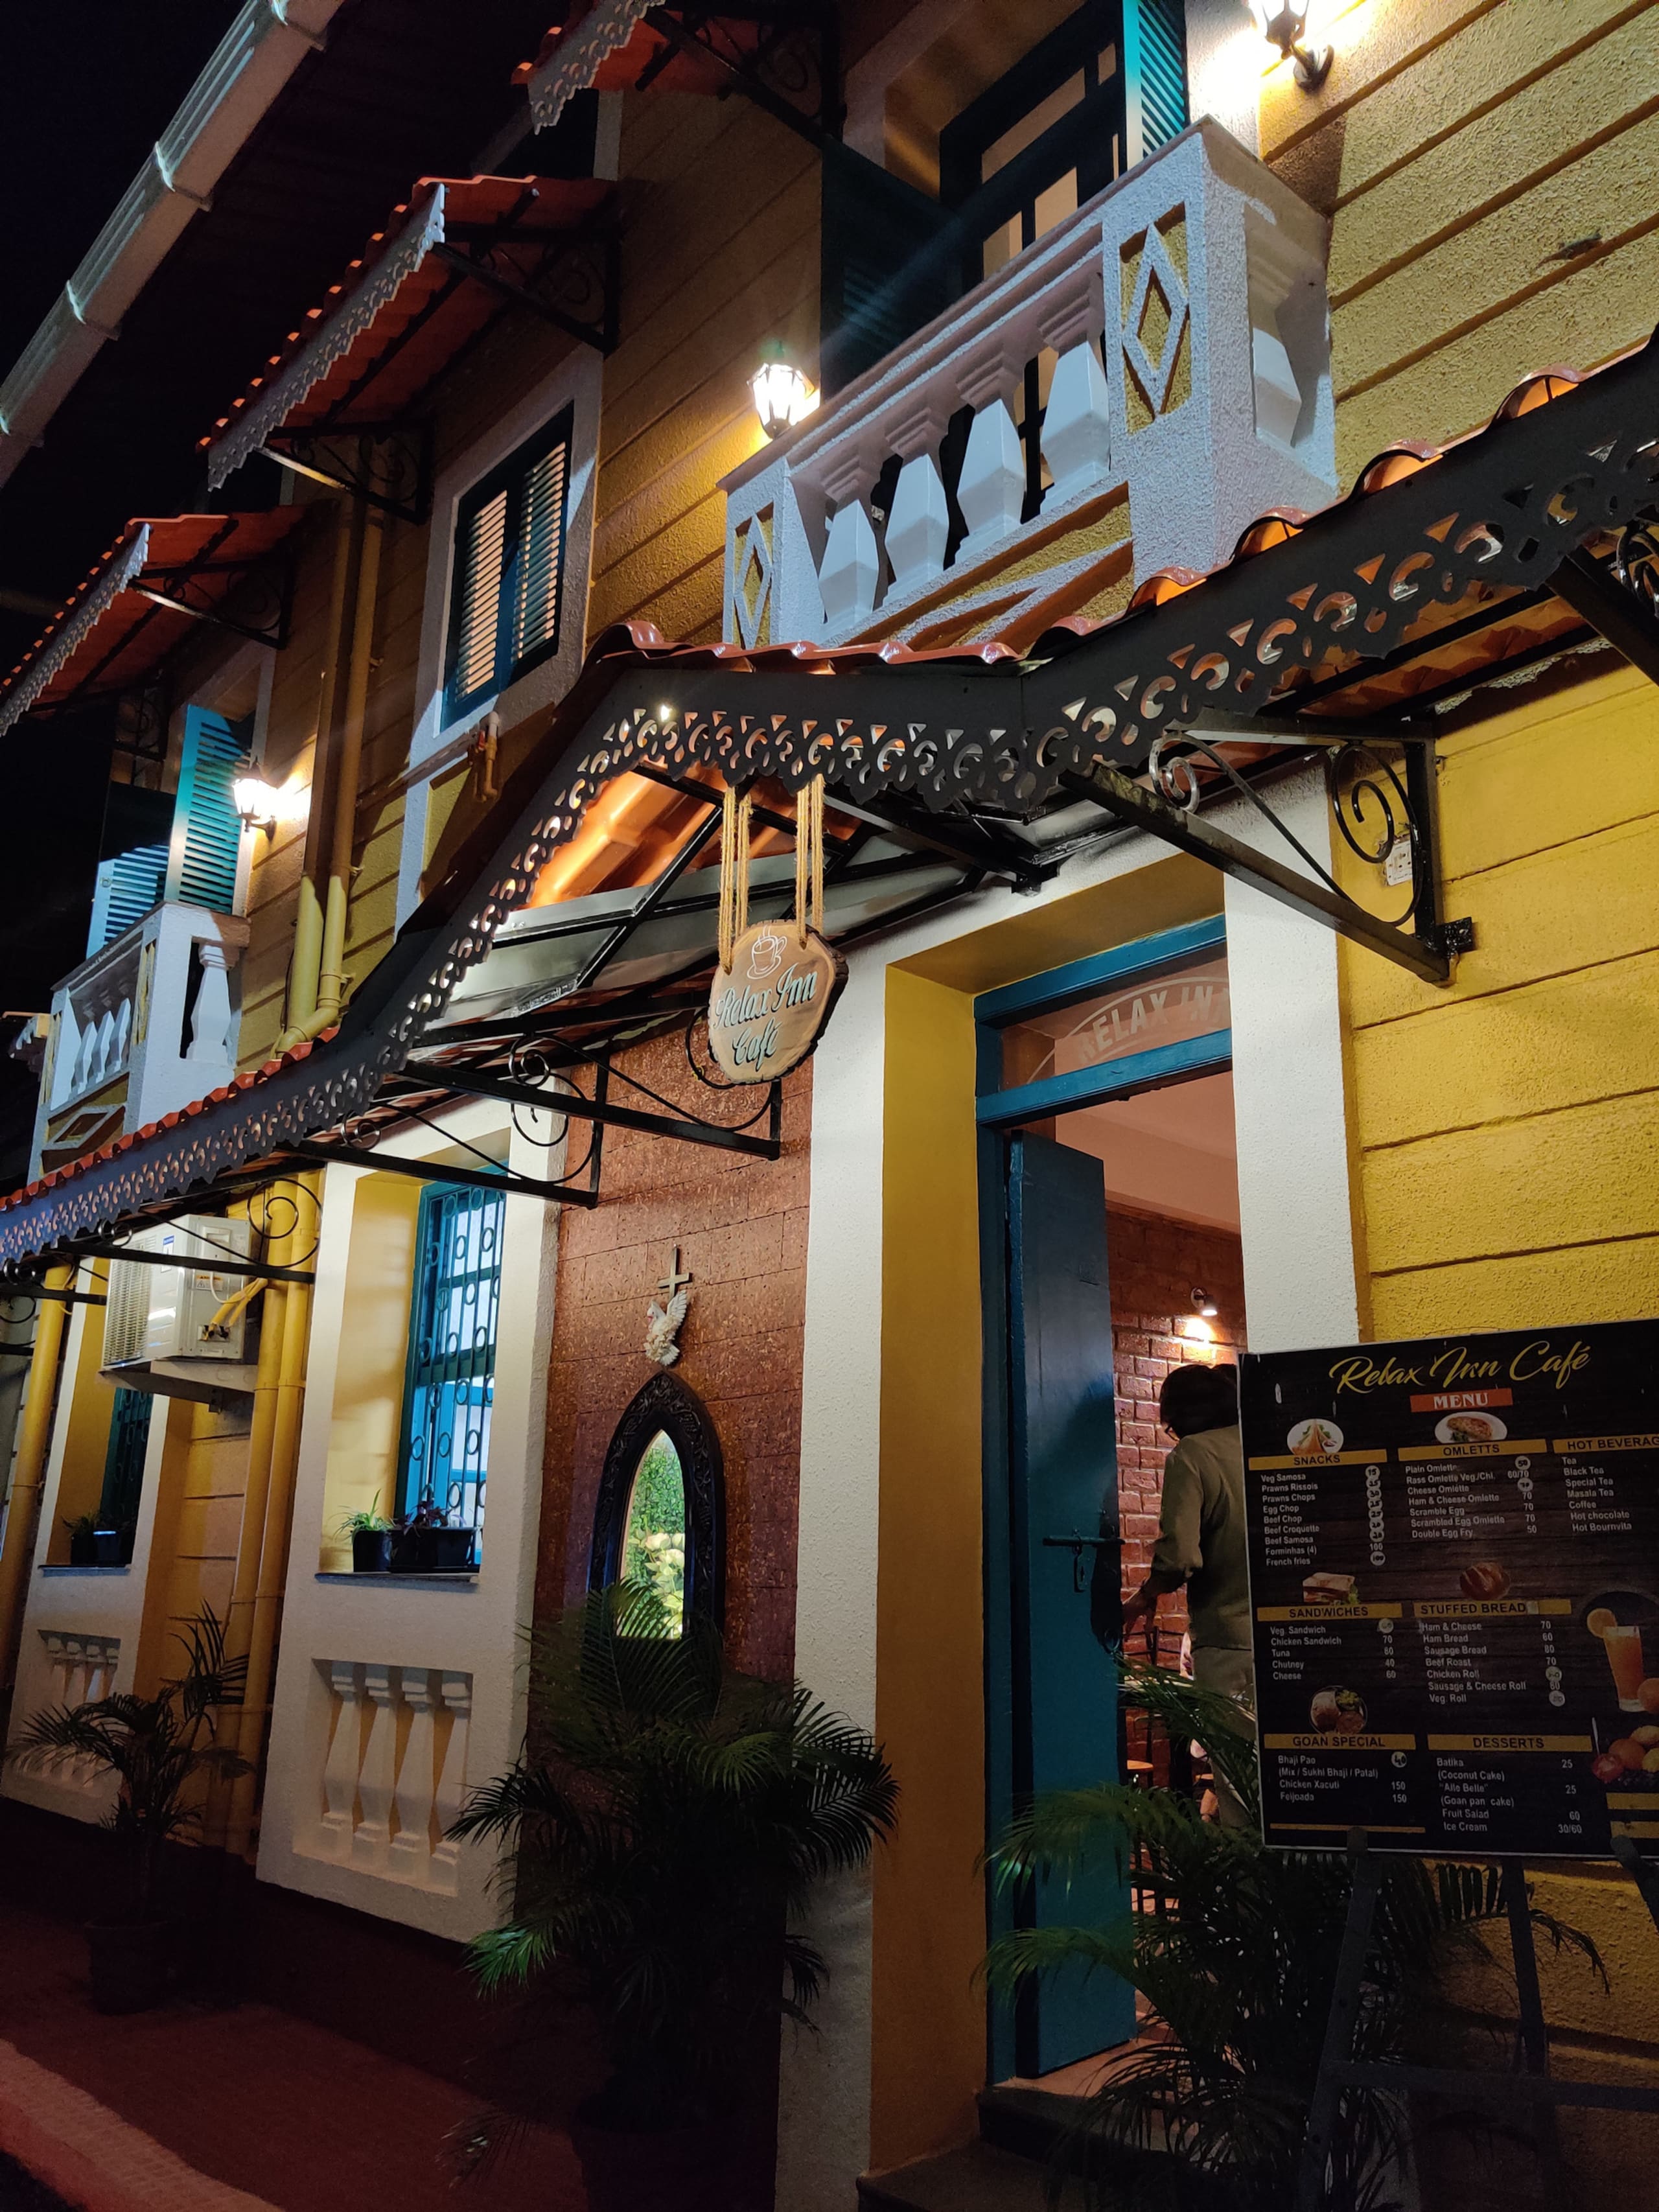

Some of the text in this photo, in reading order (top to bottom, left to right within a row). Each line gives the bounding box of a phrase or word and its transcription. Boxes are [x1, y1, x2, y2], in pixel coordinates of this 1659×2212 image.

[713, 962, 818, 1029] Relax Inn
[732, 1018, 782, 1072] Café
[1328, 1339, 1592, 1395] Relax Inn Café
[1433, 1392, 1489, 1410] MENU
[1443, 1444, 1500, 1456] OMLETTS
[1567, 1440, 1592, 1450] HOT
[1294, 1455, 1341, 1465] SNACKS
[1561, 1456, 1577, 1465] Tea
[1405, 1465, 1425, 1474] Plain
[1563, 1466, 1605, 1476] Black Tea
[1260, 1473, 1306, 1483] Veg Samosa
[1406, 1476, 1426, 1485] Rass
[1565, 1477, 1614, 1488] Special Tea
[1262, 1484, 1289, 1493] Prawns
[1567, 1488, 1614, 1498] Masala Tea
[1262, 1494, 1316, 1503] Prawns Chops
[1436, 1496, 1466, 1504] Cheese
[1523, 1492, 1532, 1500] 70
[1263, 1504, 1299, 1514] Egg Chop
[1569, 1500, 1597, 1509] Coffee
[1410, 1507, 1465, 1517] Scramble Egg
[1571, 1510, 1630, 1520] Hot chocolate
[1282, 1515, 1302, 1524] Chop
[1411, 1518, 1453, 1528] Scrambled
[1455, 1517, 1471, 1526] Egg
[1525, 1514, 1535, 1522] 70
[1264, 1525, 1320, 1535] Beef Croquette
[1527, 1525, 1537, 1533] 50
[1572, 1523, 1588, 1531] Hot
[1412, 1528, 1473, 1539] Double Egg Fry
[1265, 1536, 1314, 1545] Beef Samosa
[1266, 1545, 1317, 1555] Forminhas (4)
[1266, 1557, 1310, 1566] French fries
[1290, 1607, 1369, 1618] SANDWICHES
[1421, 1603, 1526, 1615] STUFFED BREAD
[1288, 1625, 1326, 1635] Sandwich
[1422, 1622, 1441, 1631] Ham
[1451, 1622, 1483, 1631] Cheese
[1540, 1621, 1551, 1629] 70
[1271, 1636, 1342, 1646] Chicken Sandwich
[1383, 1635, 1393, 1644] 70
[1423, 1634, 1468, 1643] Ham Bread
[1271, 1649, 1291, 1657] Tuna
[1424, 1646, 1487, 1656] Sausage Bread
[1272, 1660, 1305, 1670] Chutney
[1385, 1659, 1395, 1668] 40
[1426, 1658, 1472, 1666] Beef Roast
[1546, 1657, 1557, 1666] 70
[1273, 1671, 1301, 1681] Cheese
[1427, 1669, 1479, 1679] Chicken Roll
[1428, 1681, 1464, 1692] Sausage
[1475, 1682, 1507, 1690] Cheese
[1509, 1681, 1527, 1690] Roll
[1450, 1694, 1467, 1703] Roll
[1293, 1736, 1386, 1747] GOAN SPECIAL
[1473, 1738, 1544, 1748] DESSERTS
[1278, 1755, 1316, 1765] Bhaji Pao
[1395, 1755, 1406, 1765] 40
[1561, 1759, 1573, 1768] 25
[1279, 1767, 1295, 1777] (Mix
[1327, 1768, 1349, 1778] Bhaji
[1437, 1770, 1505, 1782] (Coconut Cake)
[1279, 1780, 1312, 1789] Chicken
[1391, 1781, 1406, 1791] 150
[1566, 1785, 1577, 1794] 25
[1393, 1794, 1407, 1803] 150
[1441, 1796, 1514, 1808] (Goan pan cake)
[1442, 1808, 1489, 1819] Fruit Salad
[1569, 1811, 1580, 1821] 60
[1444, 1821, 1487, 1832] Ice Cream
[1558, 1824, 1582, 1834] 30/60
